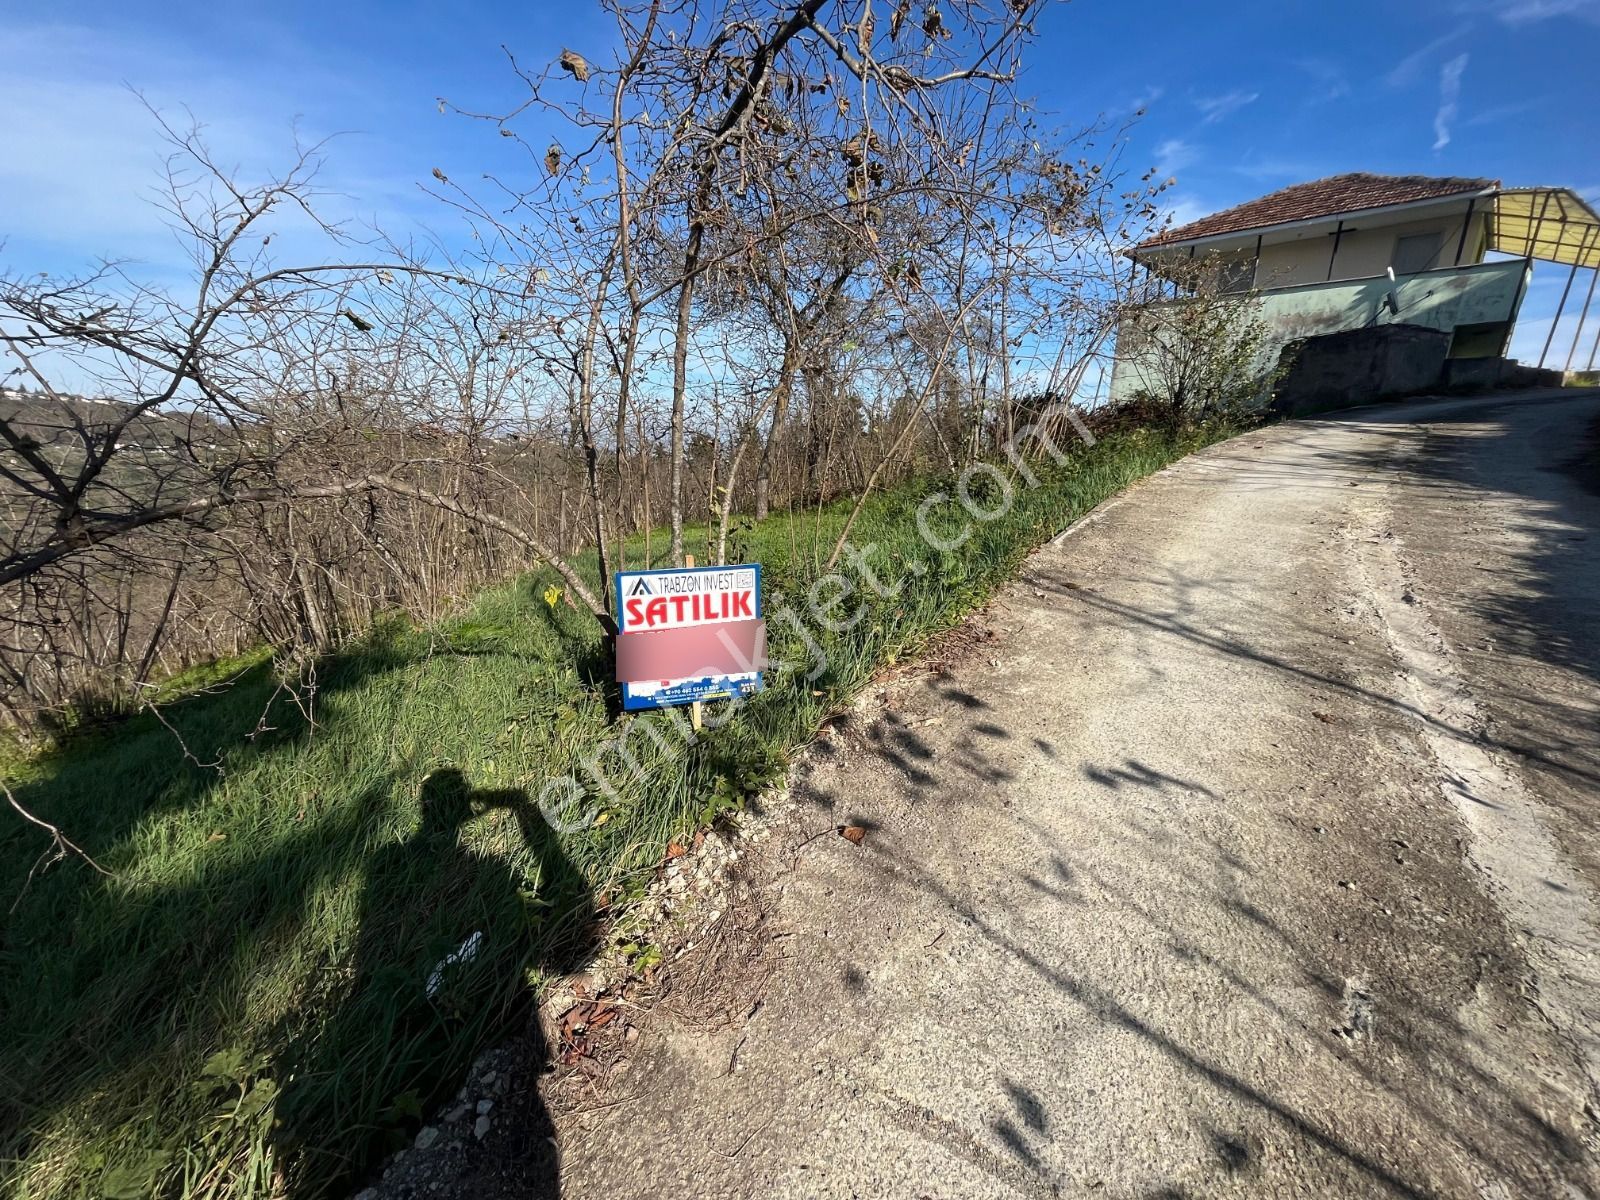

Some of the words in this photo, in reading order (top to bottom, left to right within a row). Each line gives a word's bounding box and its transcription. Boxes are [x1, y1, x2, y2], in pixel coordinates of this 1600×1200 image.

[658, 575, 701, 595] TRABZON
[704, 573, 734, 592] INVEST
[625, 590, 753, 627] SATILIK
